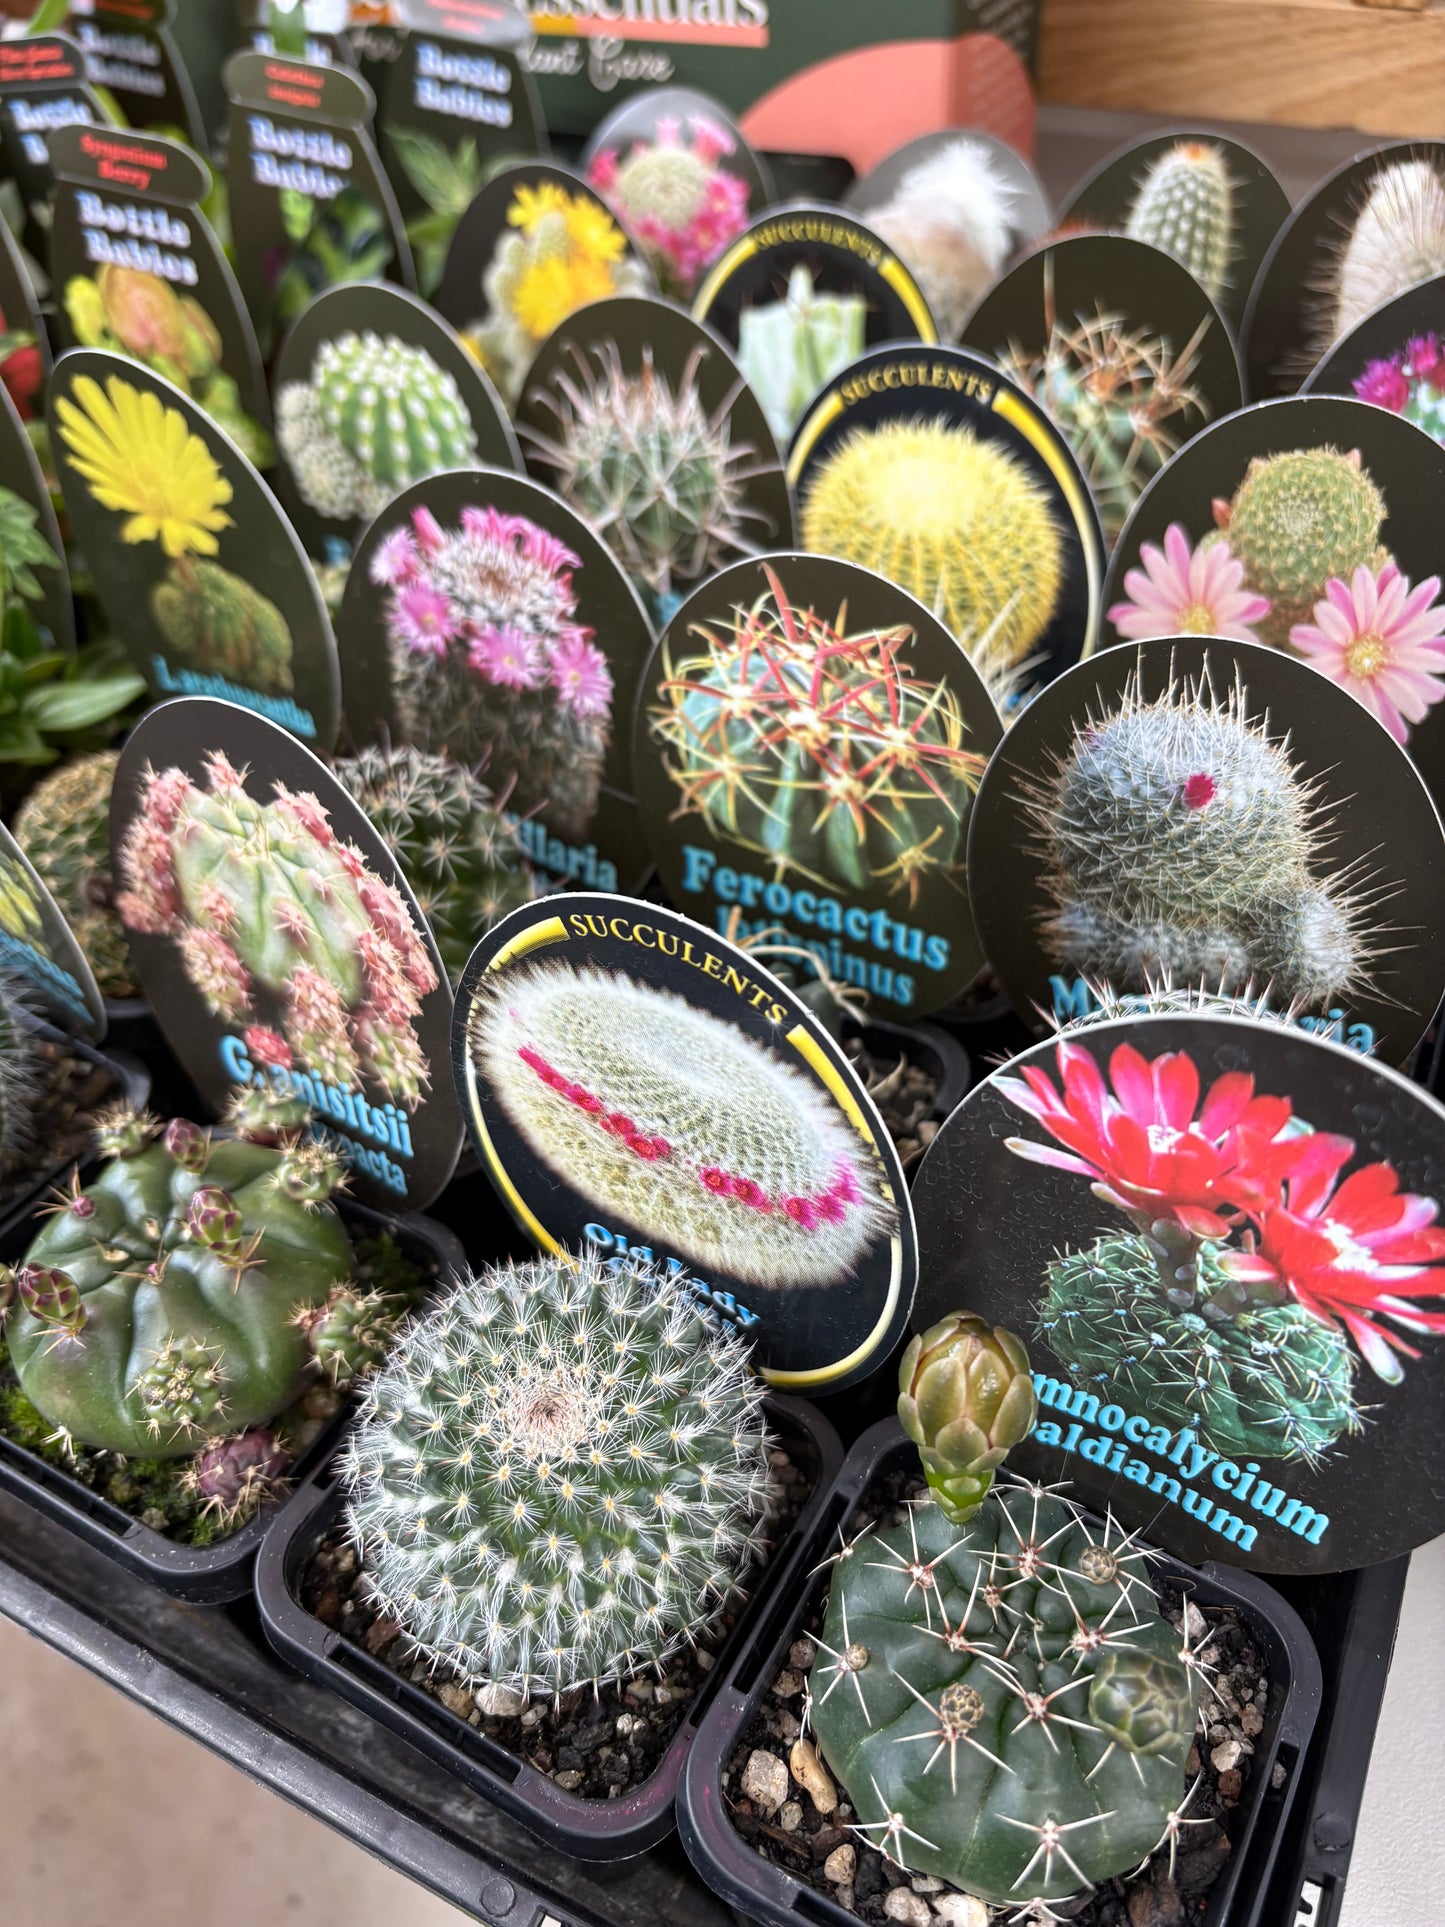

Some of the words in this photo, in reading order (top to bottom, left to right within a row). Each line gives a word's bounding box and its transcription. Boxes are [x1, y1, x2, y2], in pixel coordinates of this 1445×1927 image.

[75, 189, 191, 249] Bottle
[82, 227, 199, 286] Babies
[841, 360, 994, 405] SUCCULENTS
[682, 845, 949, 971] Ferocactus
[570, 914, 788, 1024] SUCCULENTS
[1028, 1419, 1258, 1552] aldianum
[1029, 1369, 1329, 1545] mnocalycium
